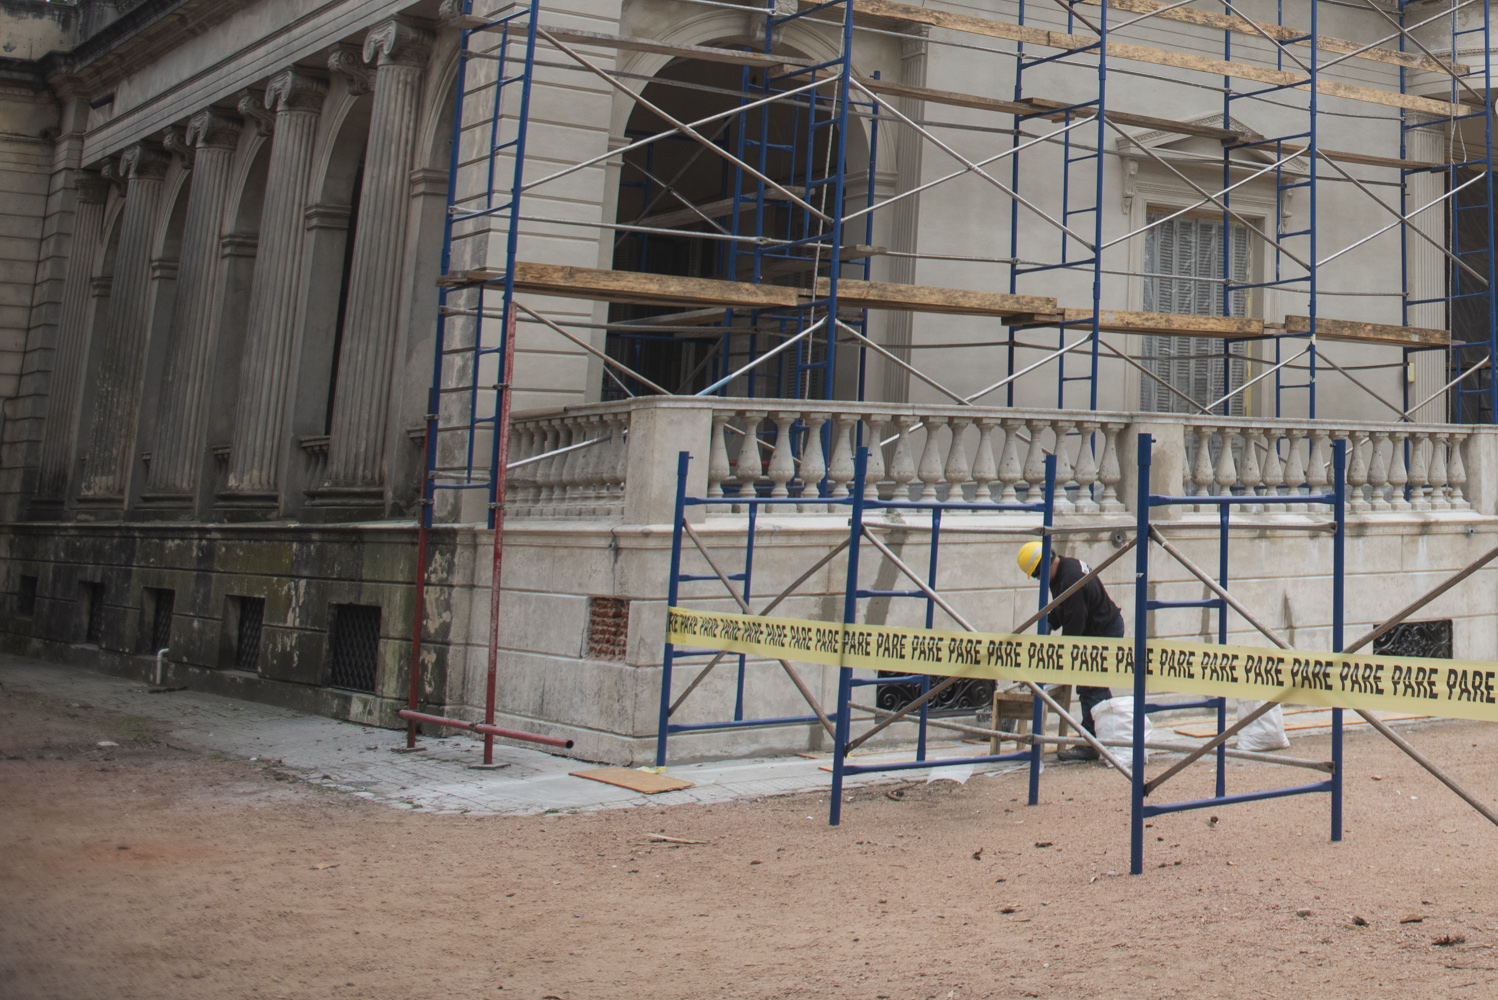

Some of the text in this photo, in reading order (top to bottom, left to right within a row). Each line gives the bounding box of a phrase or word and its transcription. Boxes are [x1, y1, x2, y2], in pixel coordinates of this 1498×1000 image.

[667, 611, 677, 632] RE
[742, 621, 764, 644] PARE
[764, 623, 788, 647] PARE
[789, 626, 812, 650] PARE
[814, 628, 840, 653] PARE
[843, 630, 872, 656] PARE
[876, 633, 907, 660] PARE
[911, 635, 944, 662] PARE
[948, 638, 982, 665] PARE
[987, 640, 1022, 668] PARE
[1028, 642, 1064, 670] PARE
[1071, 644, 1109, 673] PARE
[1116, 646, 1154, 675] PAE
[1160, 649, 1196, 679] PARE
[1200, 651, 1239, 683] PARE
[1245, 654, 1284, 687] PARE
[1290, 658, 1333, 691] PARE
[1340, 661, 1384, 695] PARE
[1392, 665, 1438, 699] PARE
[1446, 669, 1496, 704] PARE
